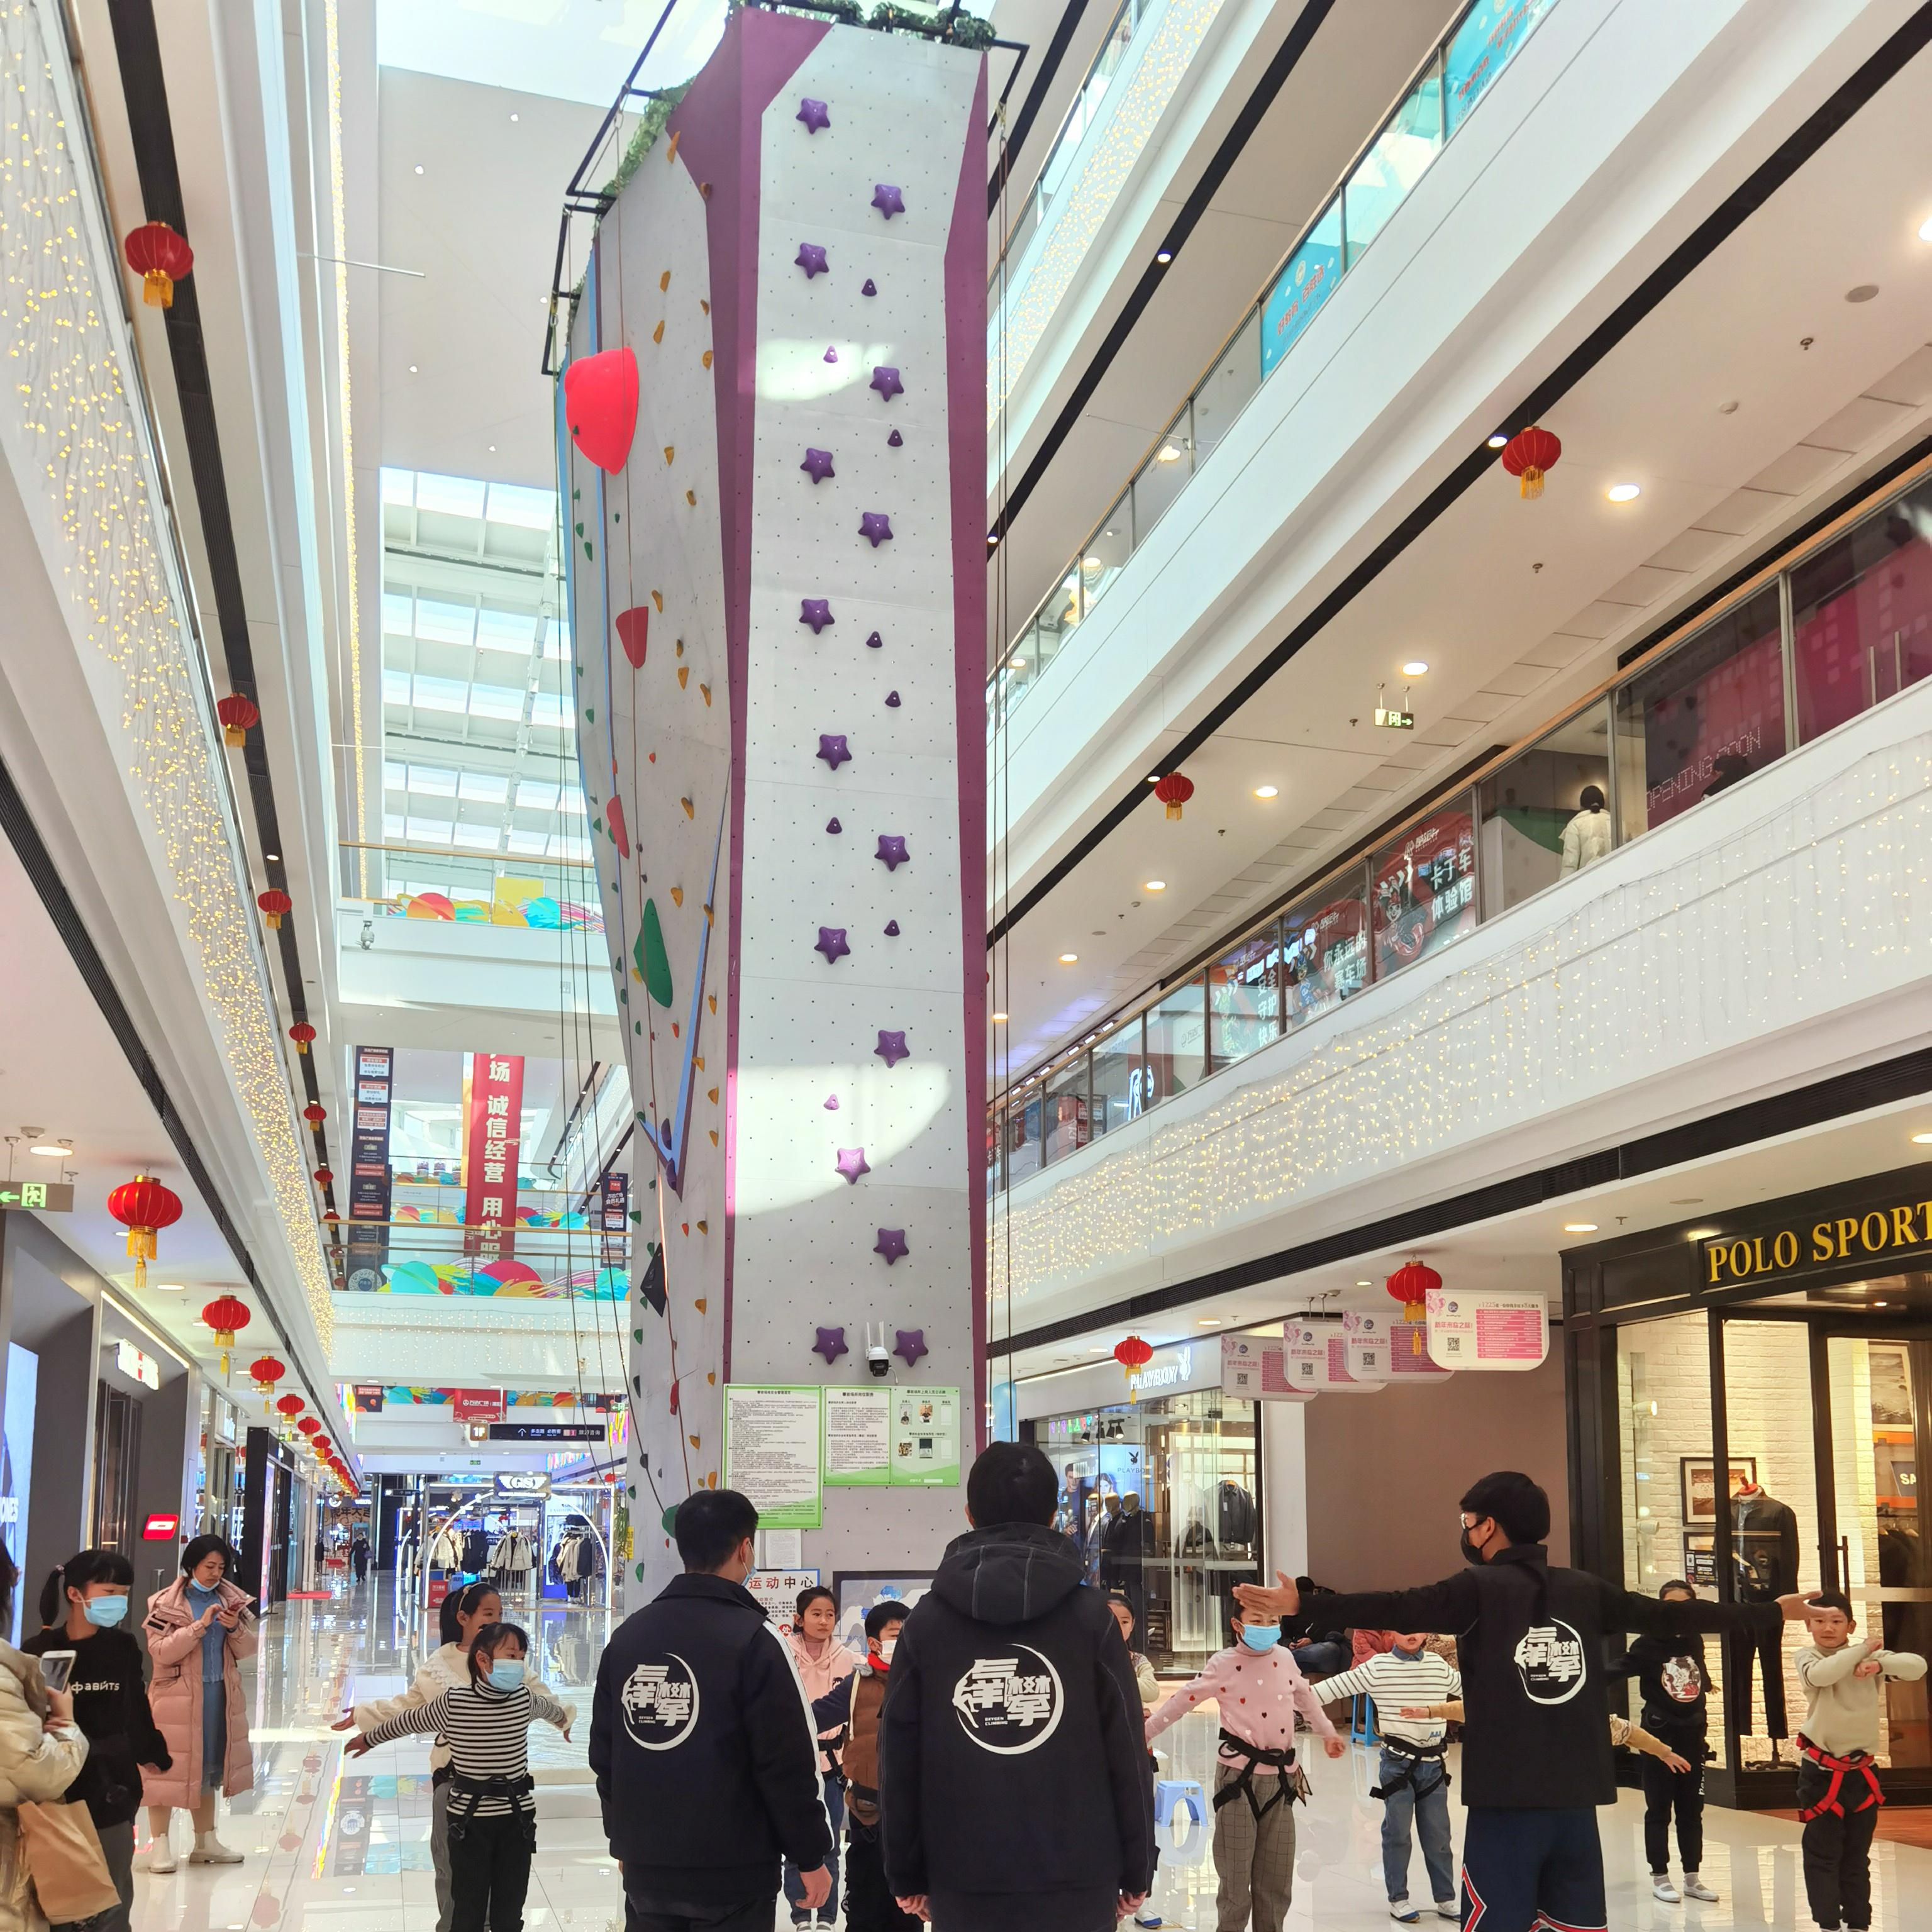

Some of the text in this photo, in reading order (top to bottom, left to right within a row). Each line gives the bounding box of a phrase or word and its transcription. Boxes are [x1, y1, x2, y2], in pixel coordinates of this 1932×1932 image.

[1431, 847, 1472, 890] 卡丁车
[1431, 877, 1472, 921] 体验馆
[1323, 930, 1367, 972] 你永远的
[484, 1095, 509, 1183] 诚信经营
[1708, 1200, 1932, 1282] POLO SPORT
[1130, 1365, 1179, 1391] PLAYBOY
[748, 1575, 814, 1589] 运动中心
